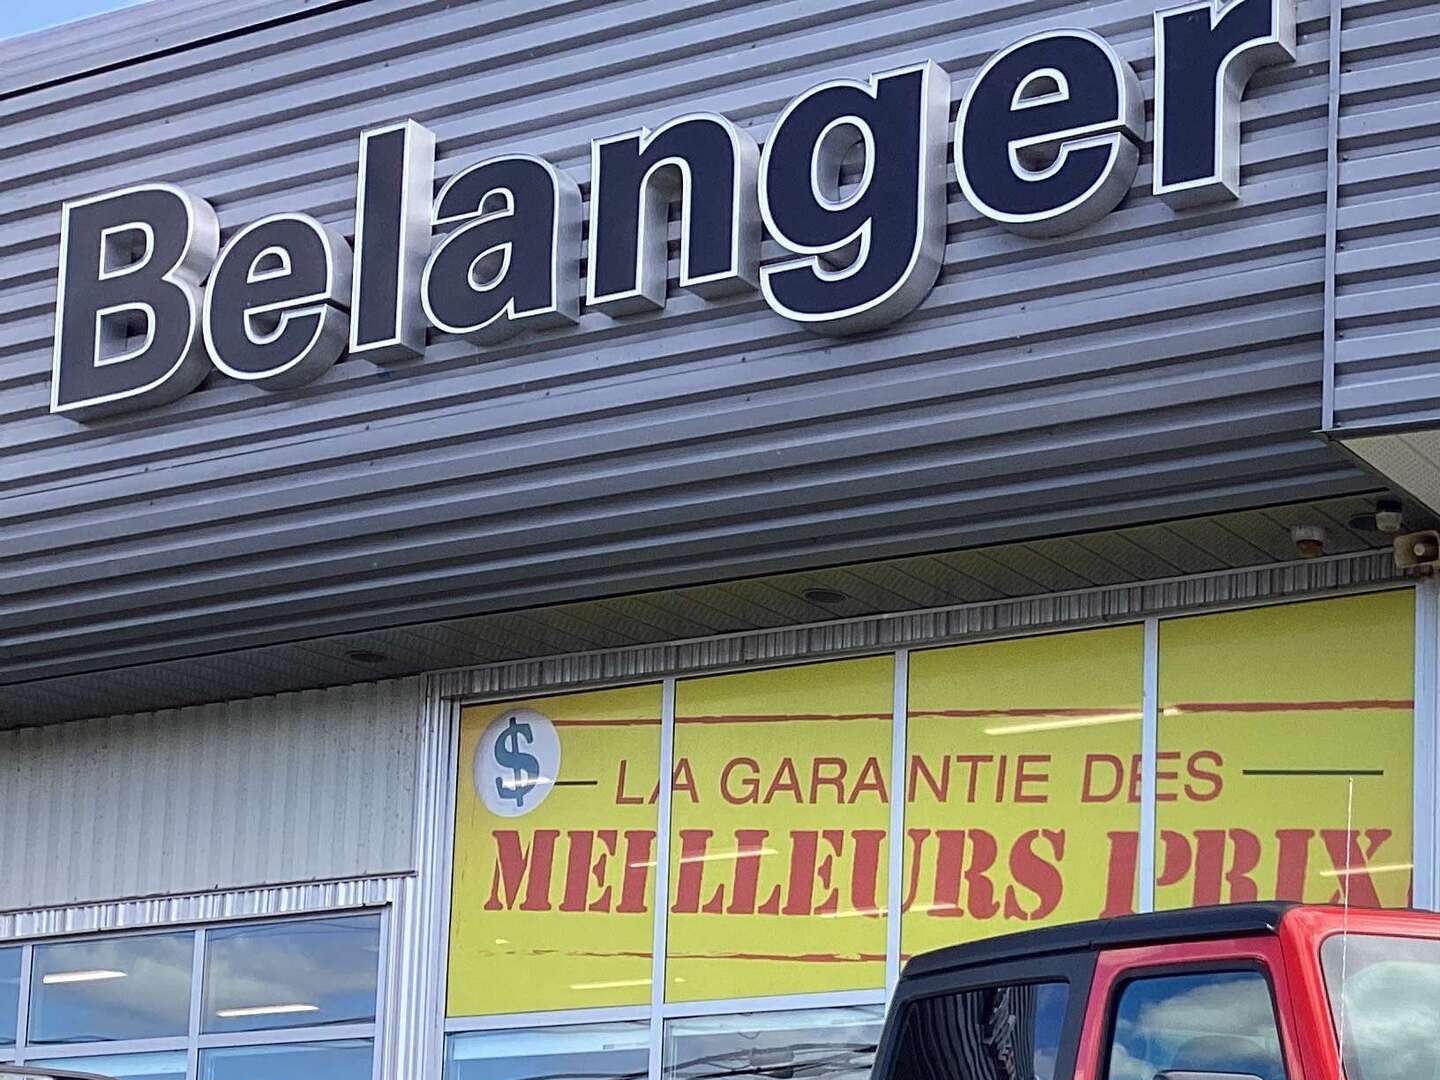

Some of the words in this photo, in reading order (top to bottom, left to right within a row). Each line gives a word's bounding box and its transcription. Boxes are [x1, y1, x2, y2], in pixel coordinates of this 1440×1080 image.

[50, 0, 1297, 420] Belanger
[615, 757, 700, 805] LA
[719, 754, 1052, 805] GARANTIE
[1081, 750, 1223, 803] DES
[483, 828, 1066, 921] MEILLEURS
[1099, 827, 1393, 918] PRIX
